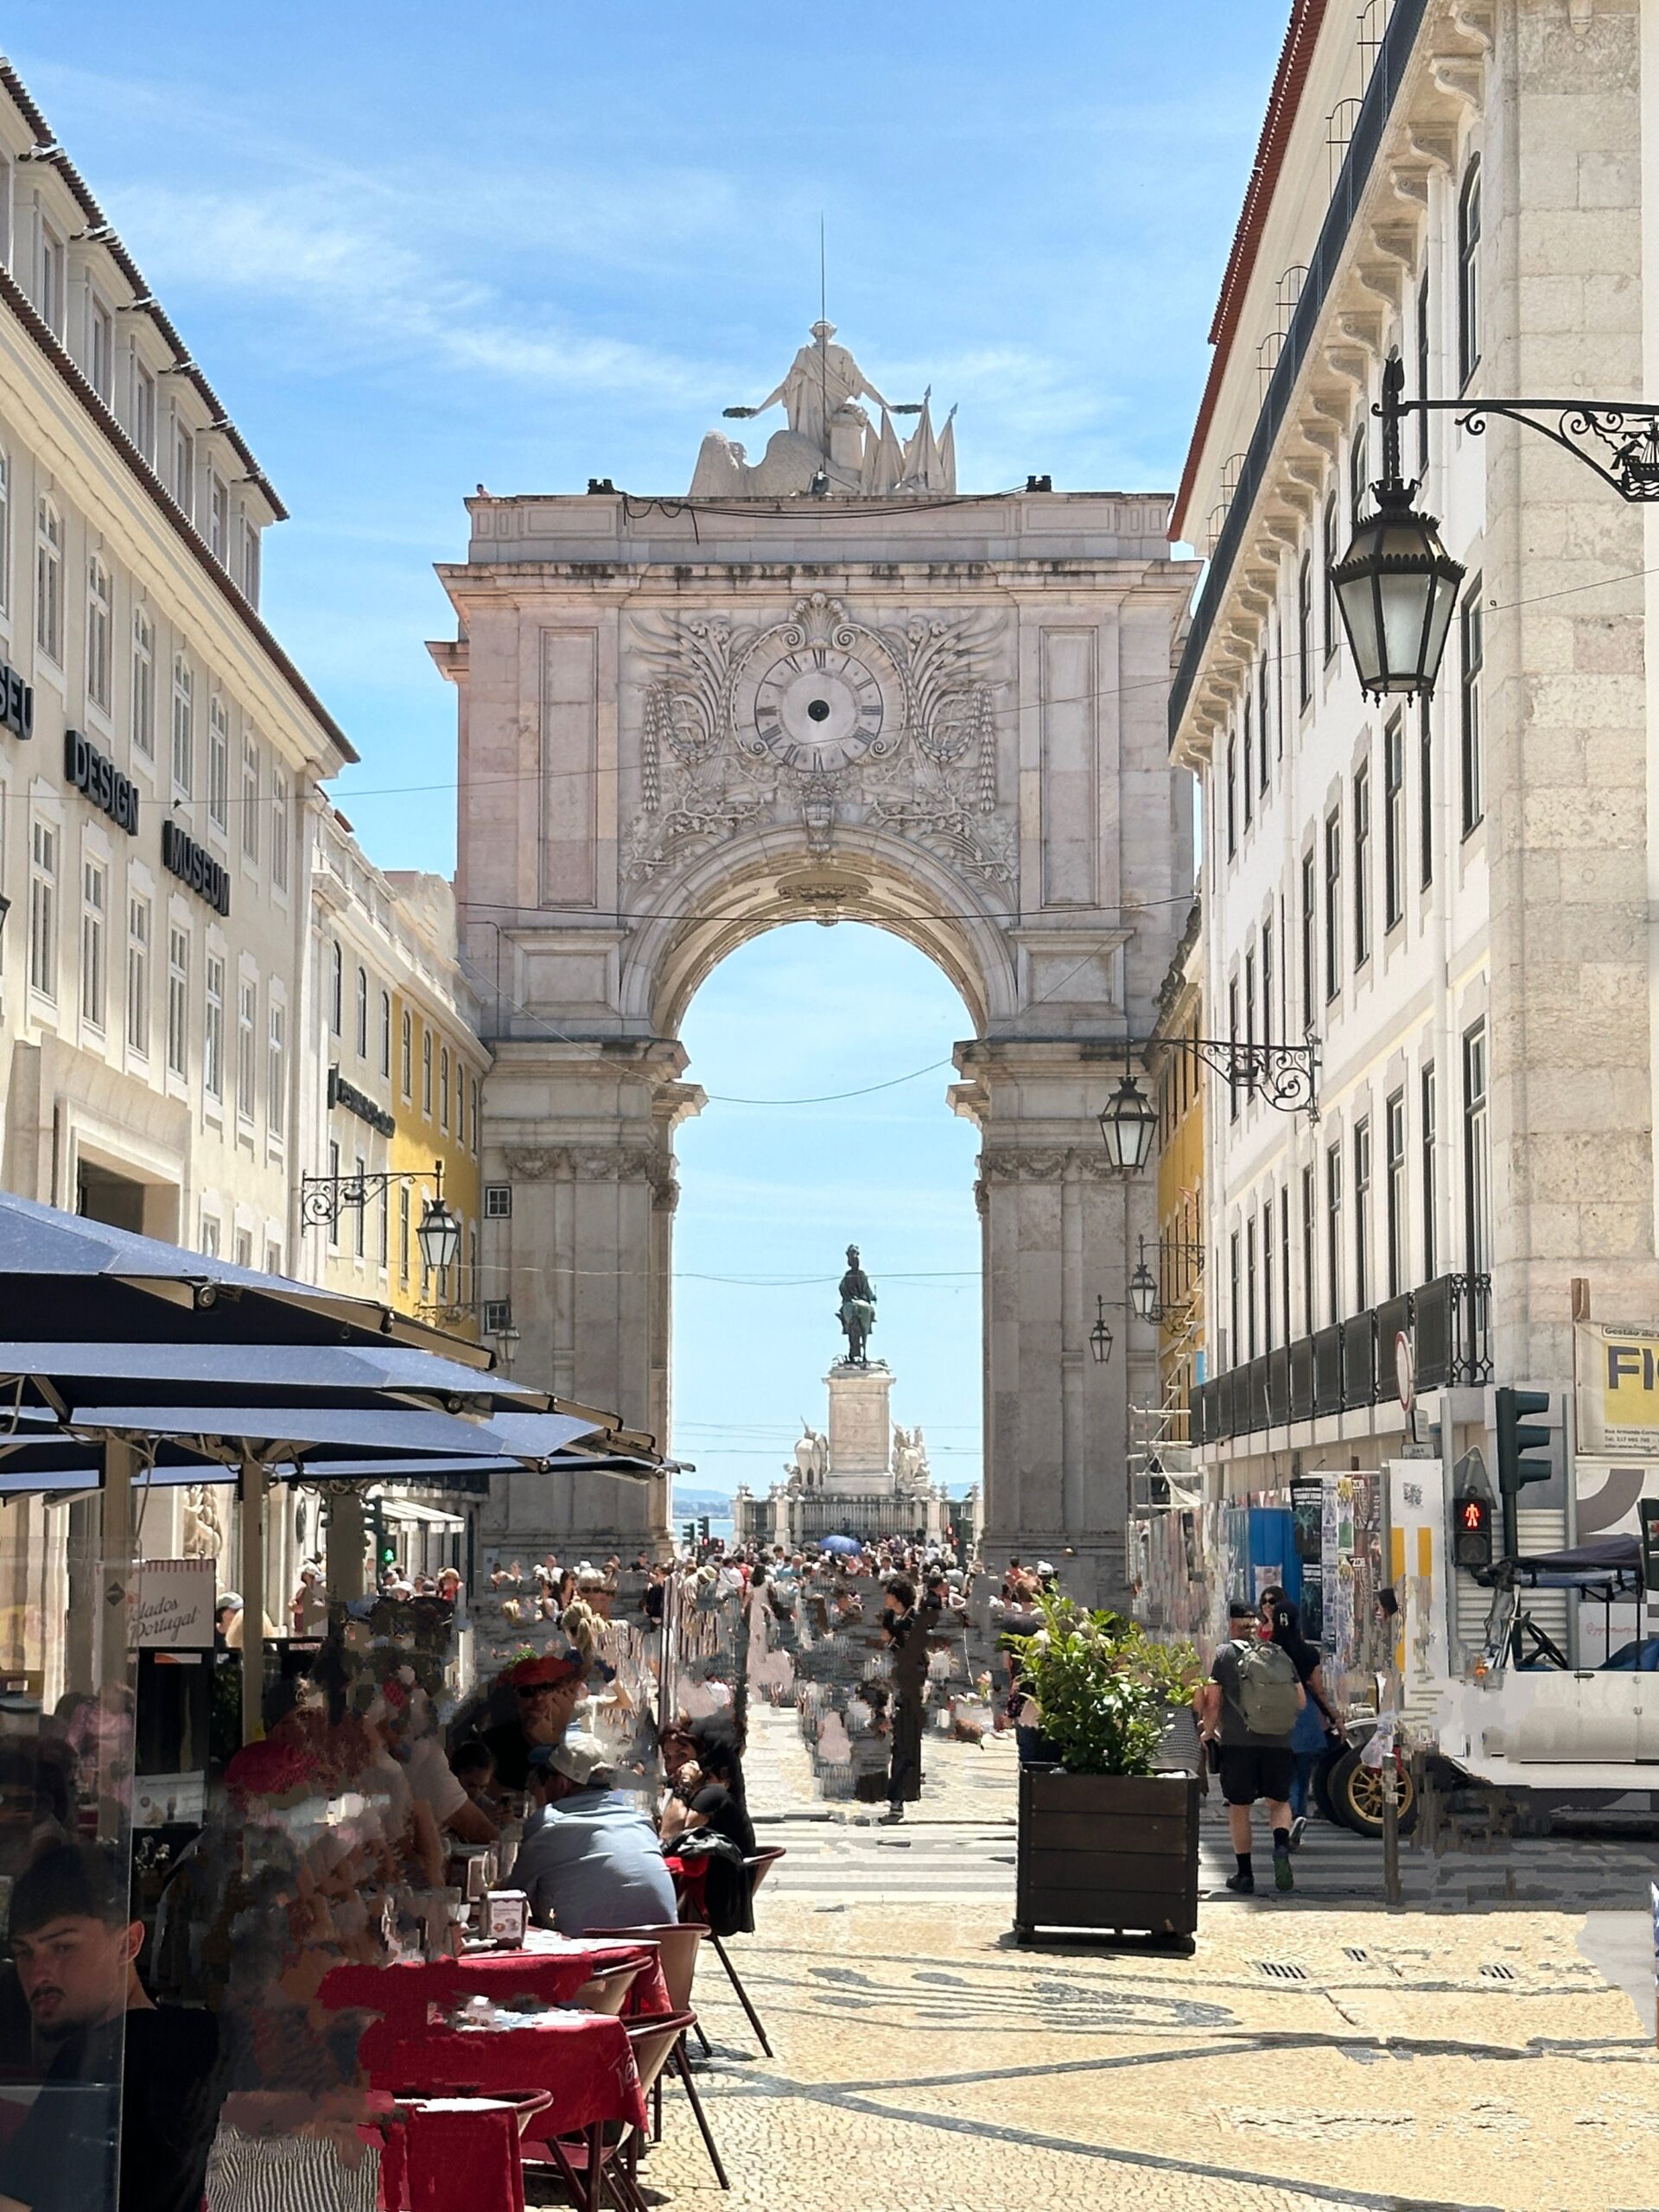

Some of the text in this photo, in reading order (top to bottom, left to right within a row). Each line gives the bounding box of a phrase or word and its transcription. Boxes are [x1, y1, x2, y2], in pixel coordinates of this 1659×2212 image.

[66, 729, 139, 836] DESIGN
[163, 819, 230, 917] MUSEUM
[1608, 1345, 1659, 1390] FI
